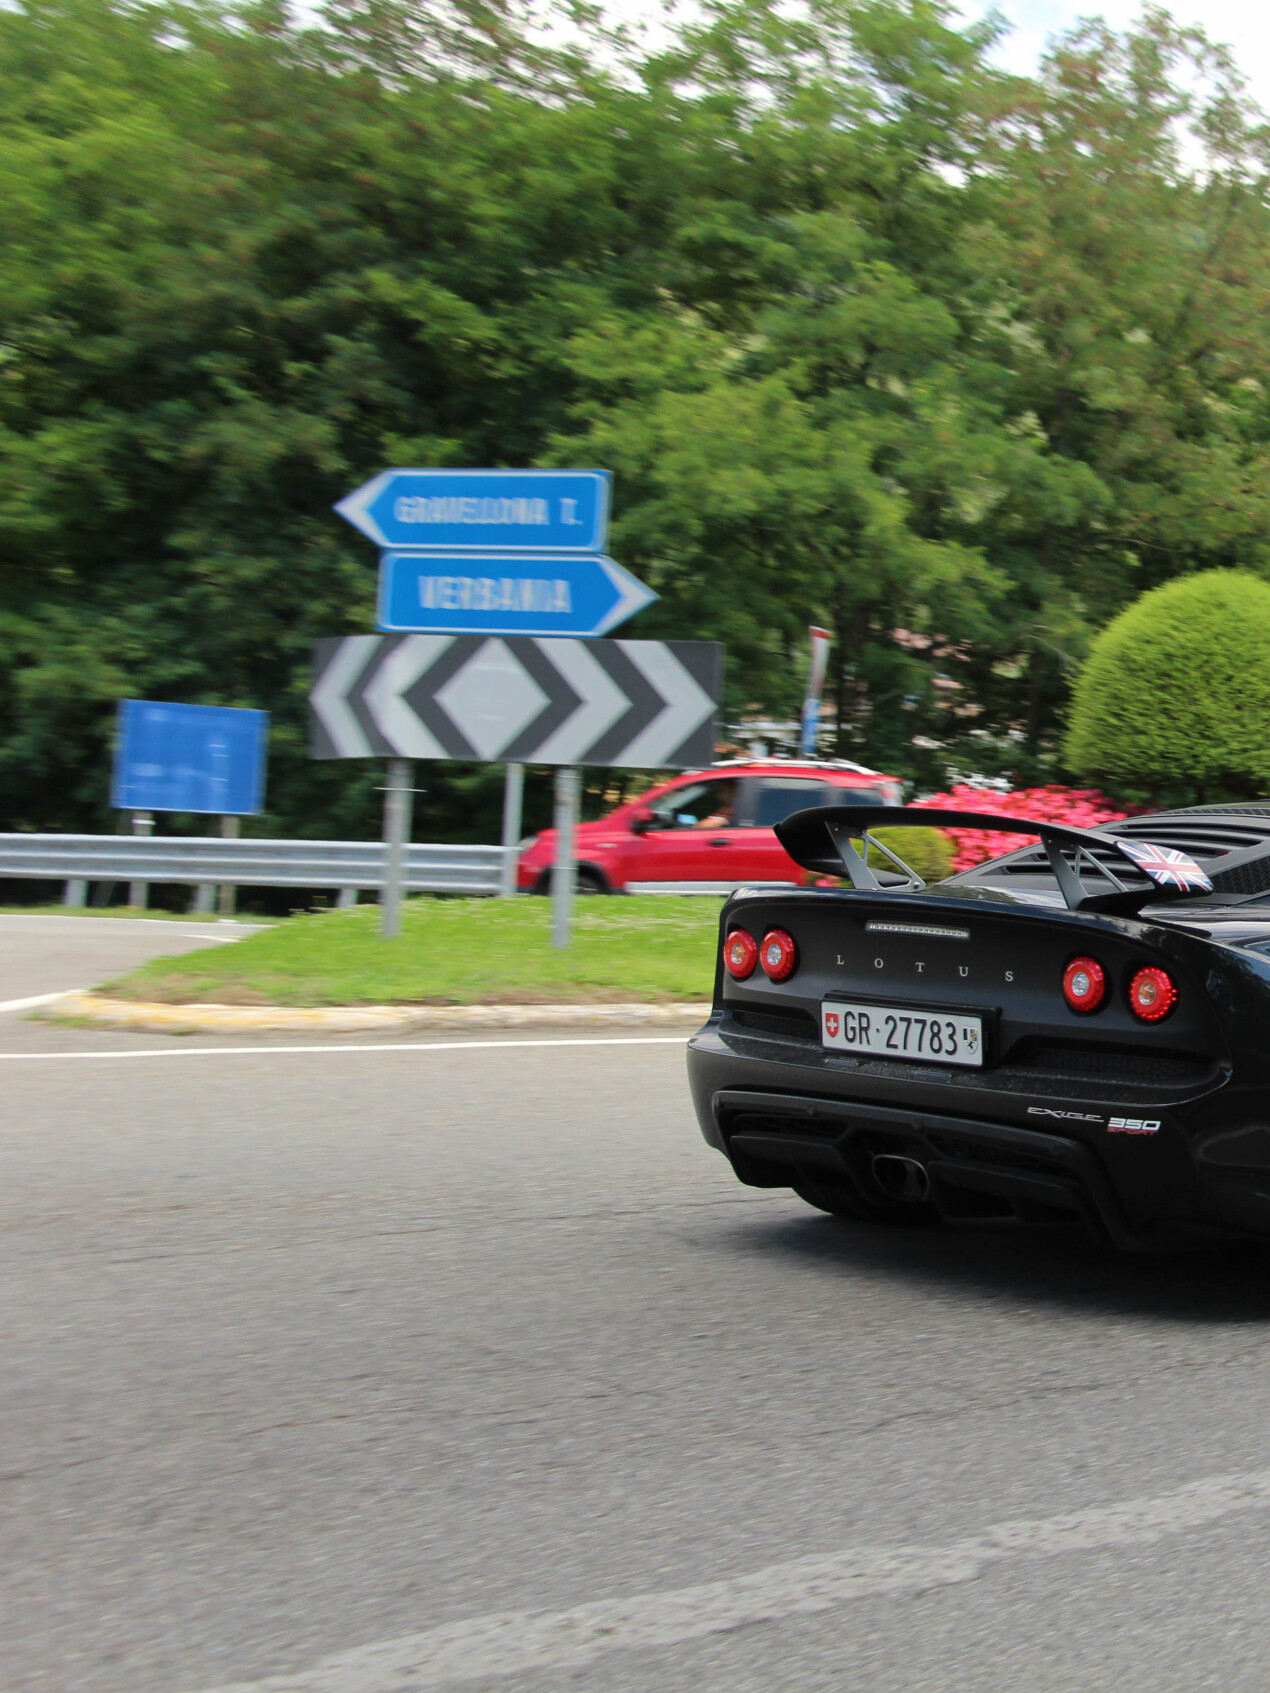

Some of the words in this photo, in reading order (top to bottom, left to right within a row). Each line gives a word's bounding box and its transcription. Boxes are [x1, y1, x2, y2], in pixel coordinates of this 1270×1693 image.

[418, 575, 571, 613] VERBANIA
[836, 954, 1015, 983] LOTUS
[1027, 1106, 1104, 1122] EXIGE
[1108, 1117, 1161, 1130] 350
